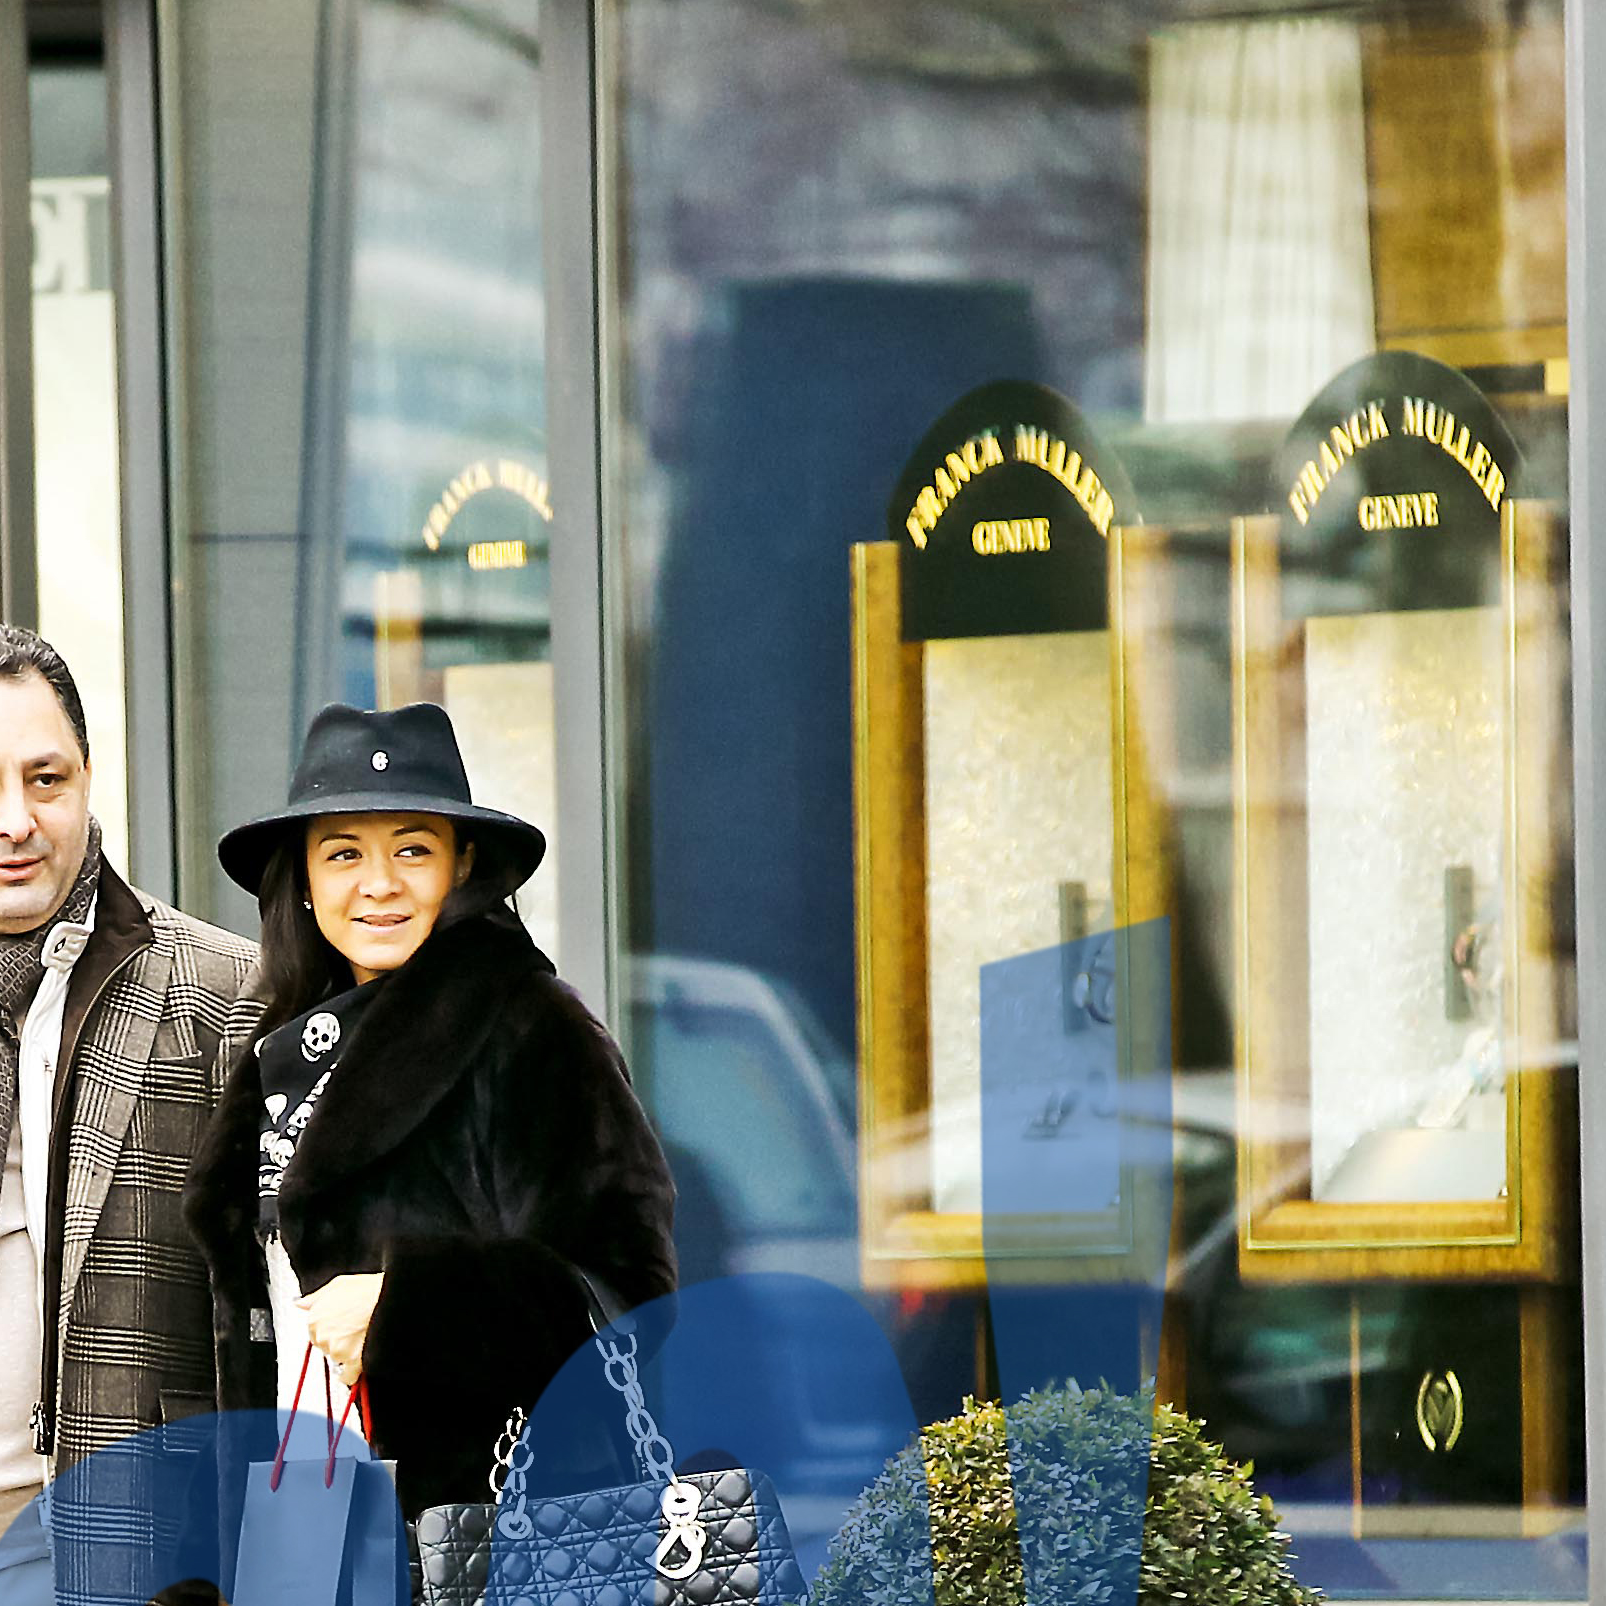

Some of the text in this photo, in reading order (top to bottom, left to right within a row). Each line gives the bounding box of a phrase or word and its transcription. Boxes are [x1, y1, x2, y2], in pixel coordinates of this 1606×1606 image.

[906, 424, 1114, 550] FRANCK MULLER
[1289, 396, 1505, 526] FRANCK MULLER
